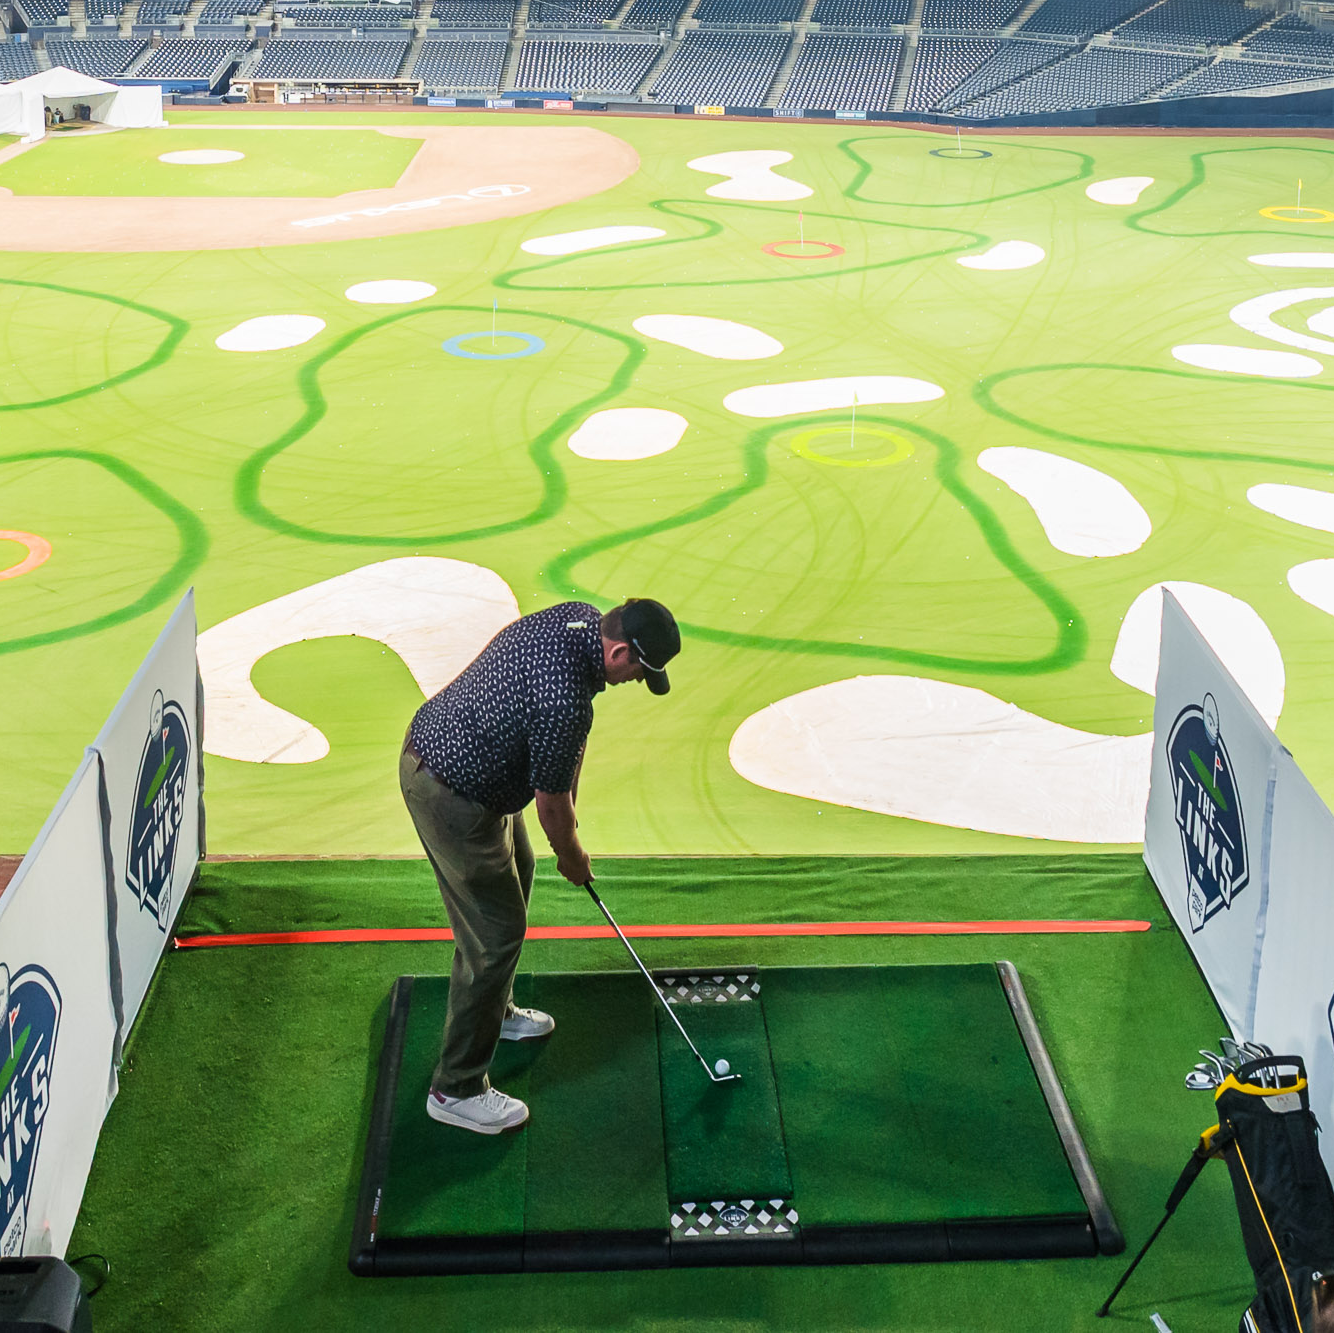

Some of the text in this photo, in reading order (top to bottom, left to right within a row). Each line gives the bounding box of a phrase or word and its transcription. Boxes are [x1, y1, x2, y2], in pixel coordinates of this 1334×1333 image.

[152, 779, 169, 825] THE
[1197, 782, 1216, 831] THE
[138, 775, 183, 908] LINKS
[1176, 777, 1233, 906] LINKS
[7, 1184, 15, 1214] AT
